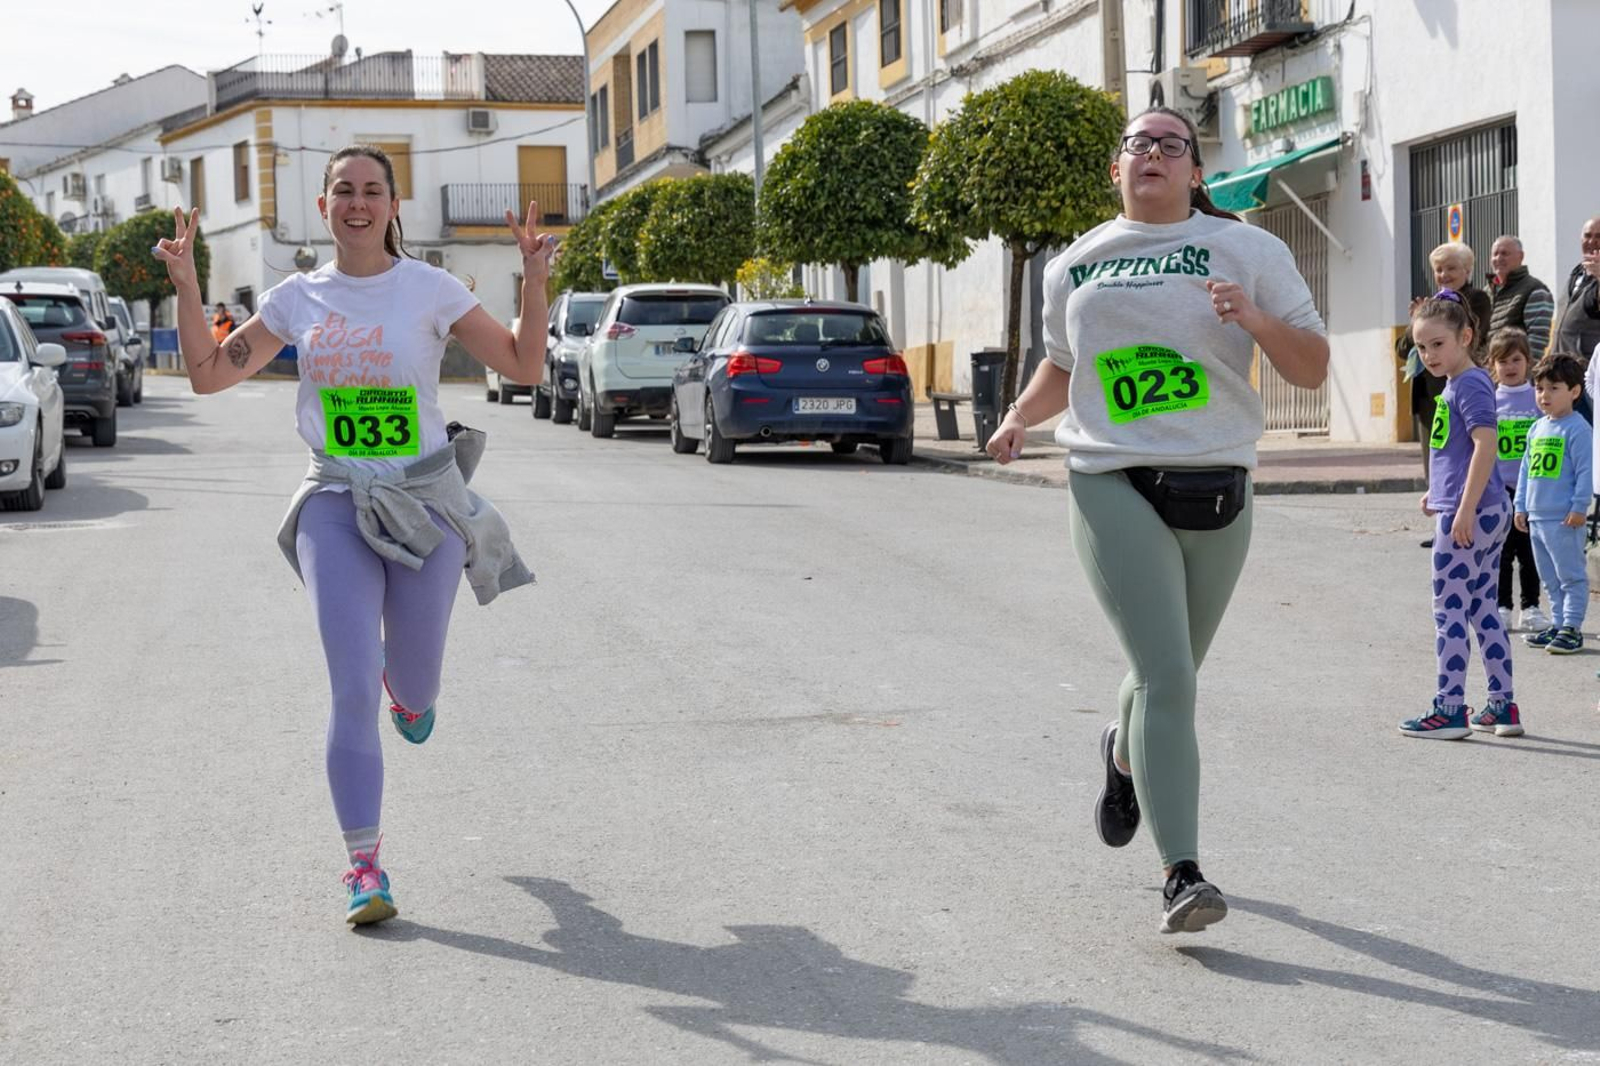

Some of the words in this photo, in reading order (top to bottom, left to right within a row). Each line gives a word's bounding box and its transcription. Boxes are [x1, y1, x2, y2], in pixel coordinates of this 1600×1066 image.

[1251, 78, 1324, 134] FARMACIA
[309, 323, 384, 351] ROSA
[359, 389, 408, 397] CIRCUITO
[1112, 366, 1200, 411] 023
[355, 396, 413, 404] RUNNING
[802, 400, 829, 411] 2320
[832, 400, 853, 411] JPG
[333, 414, 411, 448] 033
[1498, 434, 1528, 454] 05
[1529, 452, 1558, 472] 20
